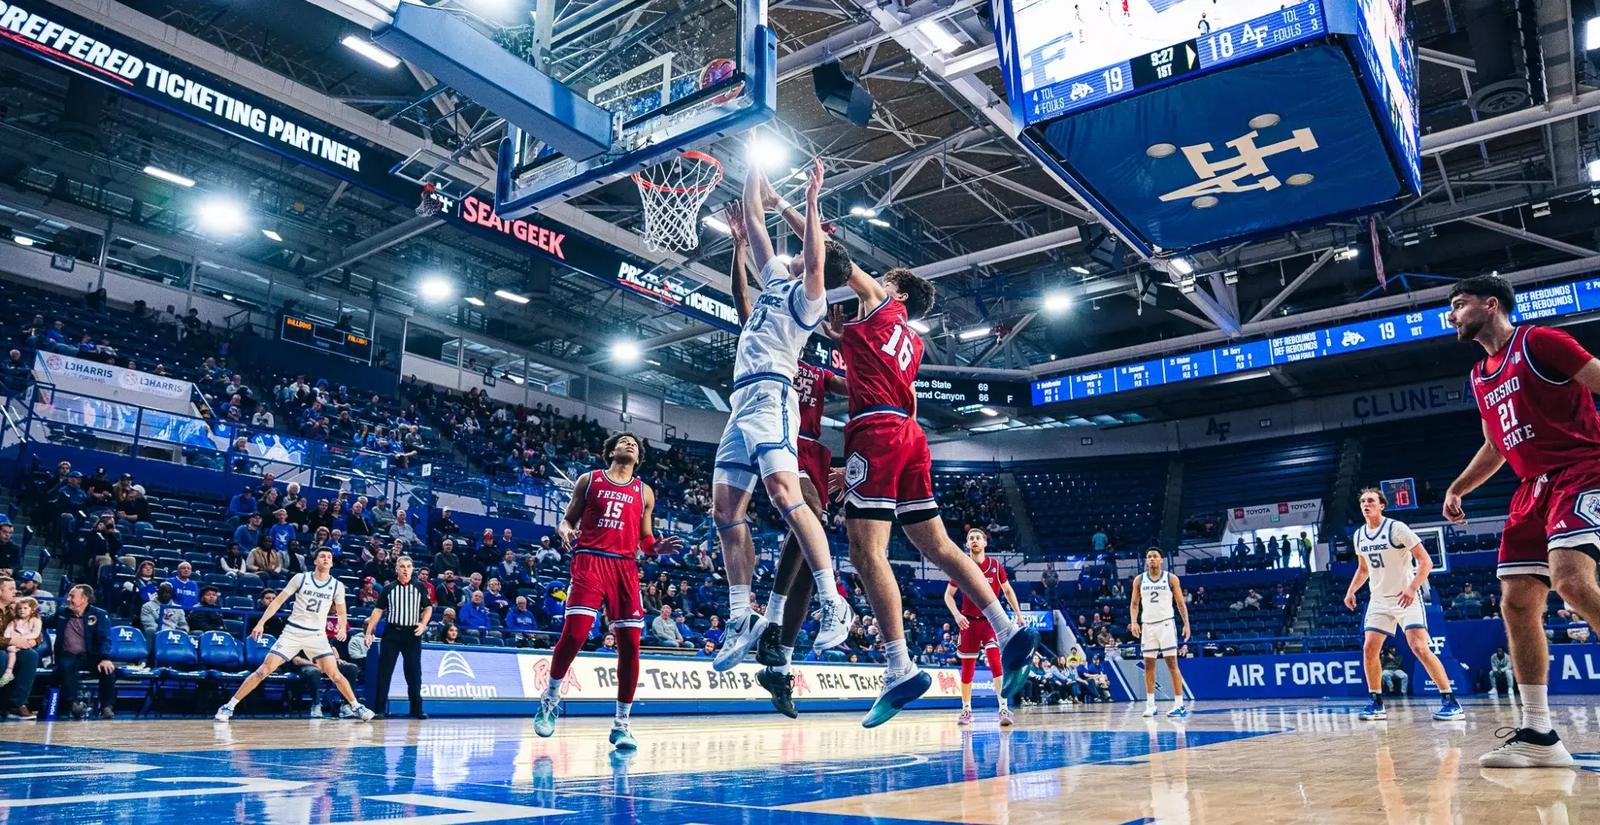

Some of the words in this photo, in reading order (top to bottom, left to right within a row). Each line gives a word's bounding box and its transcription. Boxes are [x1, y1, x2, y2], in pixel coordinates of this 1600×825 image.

[1282, 9, 1300, 24] TOL
[1308, 3, 1316, 15] 3
[1240, 23, 1269, 48] AF
[1273, 23, 1302, 42] FOULS
[1311, 18, 1318, 30] 3
[1207, 32, 1234, 61] 18
[1150, 47, 1174, 67] 9:27
[1156, 63, 1172, 79] 1ST
[1102, 66, 1123, 95] 19
[1032, 91, 1039, 102] 4
[1041, 87, 1055, 100] TOL
[1033, 105, 1040, 115] 4
[1042, 97, 1065, 114] FOULS
[145, 63, 266, 133] TICKETING
[268, 114, 361, 172] PARTNER
[1514, 292, 1529, 303] OFF
[1529, 285, 1571, 301] REBOUNDS
[1517, 301, 1531, 313] DEF
[1531, 294, 1574, 310] REBOUNDS
[1521, 311, 1538, 321] TEAM
[1538, 308, 1557, 317] FOULS
[1378, 321, 1396, 340] 19
[1272, 337, 1284, 347] OFF
[1284, 331, 1317, 346] REBOUNDS
[1285, 340, 1318, 354] REBOUNDS
[880, 324, 914, 371] 16
[912, 379, 930, 388] oise
[931, 380, 952, 389] State
[978, 383, 989, 392] 69
[1483, 376, 1521, 410] FRESNO
[915, 390, 933, 400] rand
[933, 391, 966, 402] Canyon
[978, 393, 989, 402] 86
[1007, 395, 1013, 404] F
[1352, 385, 1447, 419] CLUNE
[1498, 398, 1519, 432] 21
[1502, 423, 1536, 451] STATE
[596, 489, 634, 504] FRESNO
[1395, 490, 1409, 506] 10
[603, 500, 625, 519] 15
[1246, 507, 1271, 515] TOYOTA
[1290, 502, 1316, 510] TOYOTA
[597, 518, 625, 530] STATE
[1370, 543, 1388, 551] FORCE
[1368, 553, 1385, 568] 51
[312, 591, 331, 600] FORCE
[1150, 591, 1159, 603] 2
[305, 598, 322, 613] 21
[119, 628, 133, 641] AF
[167, 631, 181, 643] AF
[211, 632, 225, 645] AF
[646, 668, 702, 690] TEXAS
[1227, 664, 1265, 686] AIR
[1274, 660, 1363, 685] FORCE
[817, 673, 851, 690] REAL
[420, 683, 497, 698] amentum
